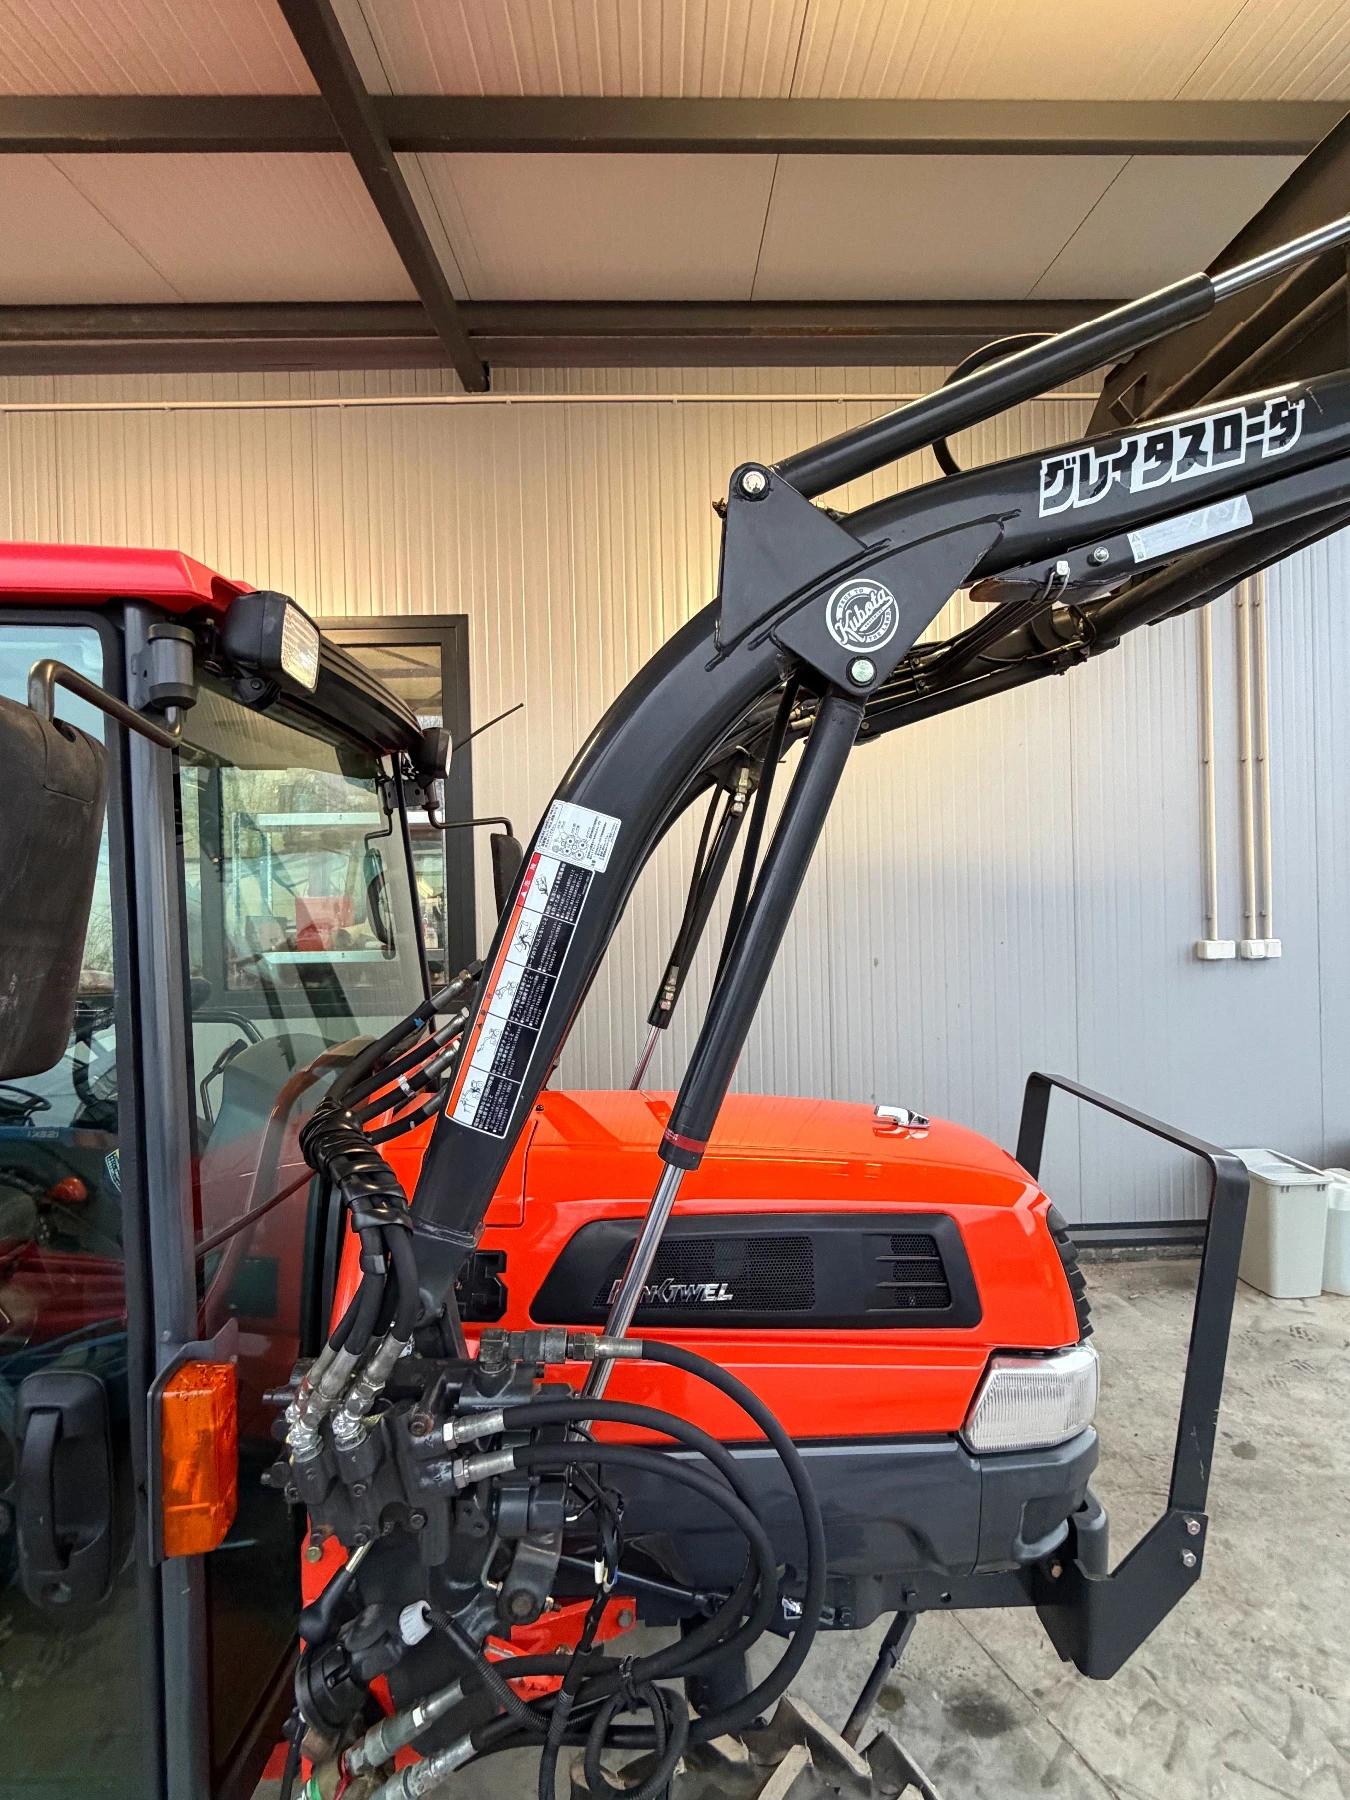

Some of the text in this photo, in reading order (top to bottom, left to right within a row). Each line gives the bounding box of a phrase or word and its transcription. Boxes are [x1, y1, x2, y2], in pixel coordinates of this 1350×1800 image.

[1039, 396, 1305, 518] グレイタスローダ
[834, 588, 893, 643] Kubota
[868, 611, 891, 641] THE LAND
